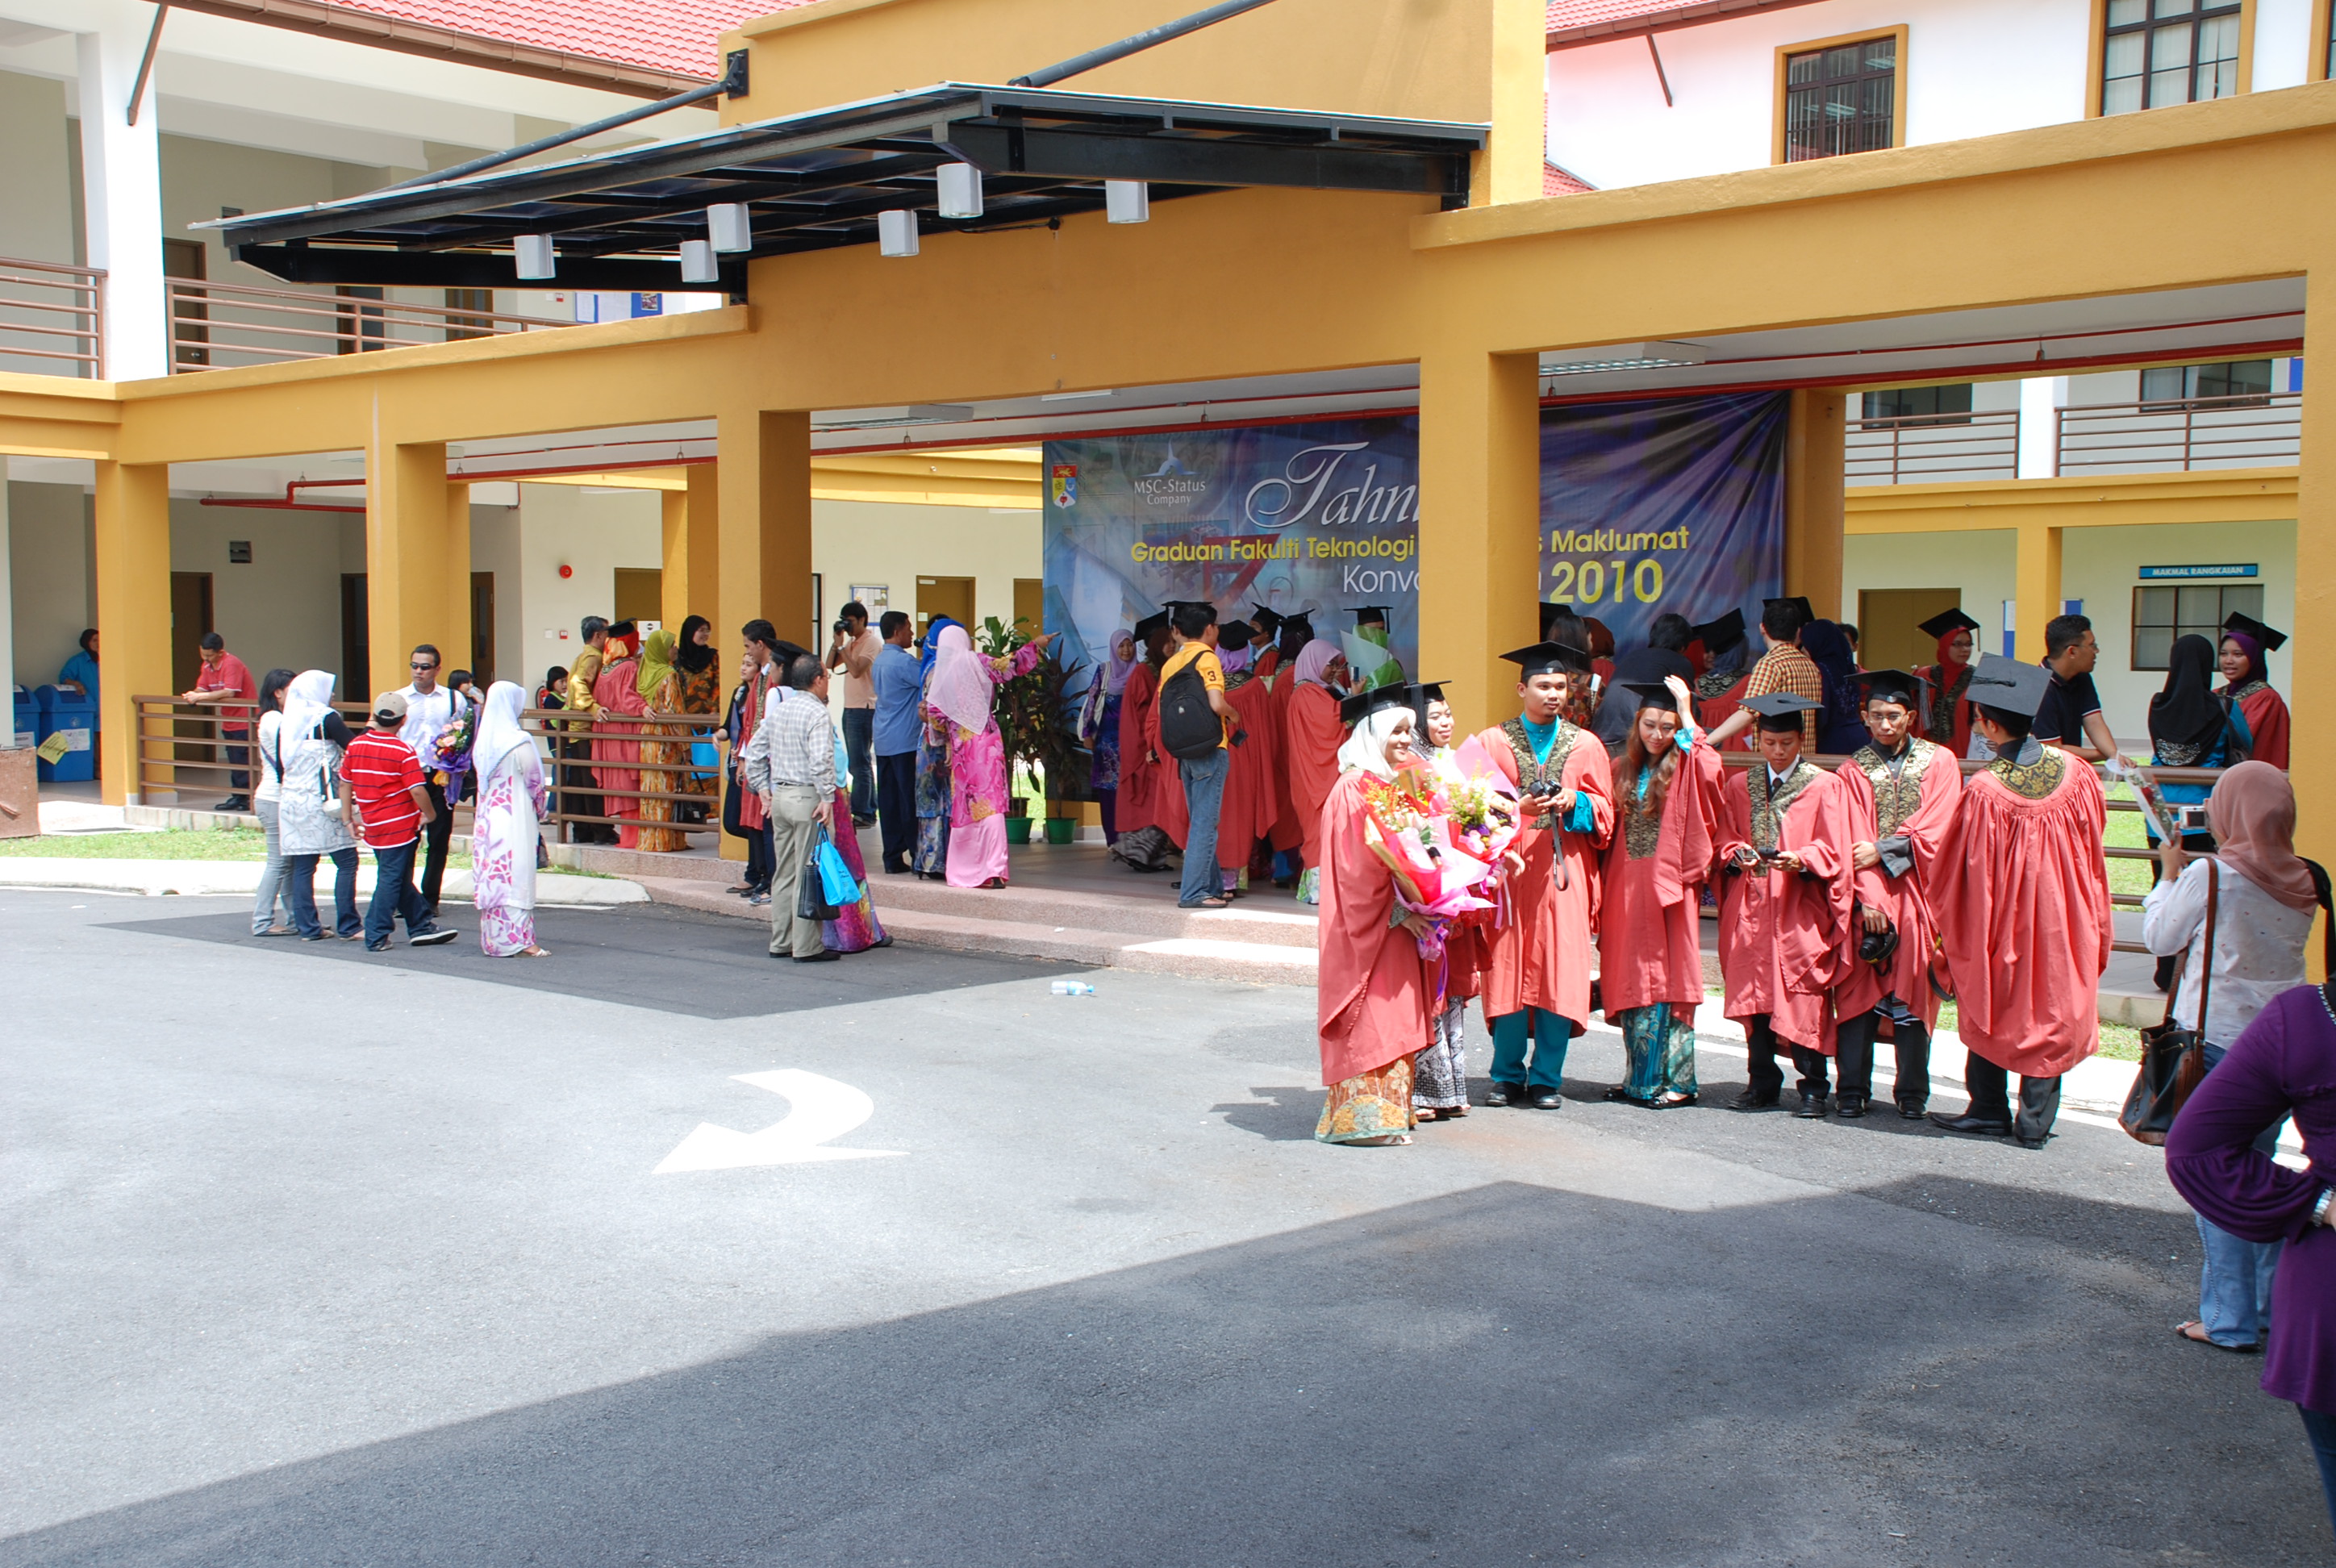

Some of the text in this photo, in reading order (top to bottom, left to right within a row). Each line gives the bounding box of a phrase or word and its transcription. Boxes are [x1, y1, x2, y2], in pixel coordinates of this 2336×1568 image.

[1134, 479, 1206, 494] MSC-Status
[1147, 494, 1191, 507] Company
[1131, 540, 1224, 562] Graduan
[1230, 536, 1299, 561] Fakulti
[1306, 535, 1415, 562] Teknologi
[1551, 526, 1690, 553] Maklumat
[2152, 568, 2189, 576] MAKMAL
[1343, 565, 1419, 593] Konv
[1550, 558, 1663, 604] 2010
[1207, 670, 1217, 682] 3
